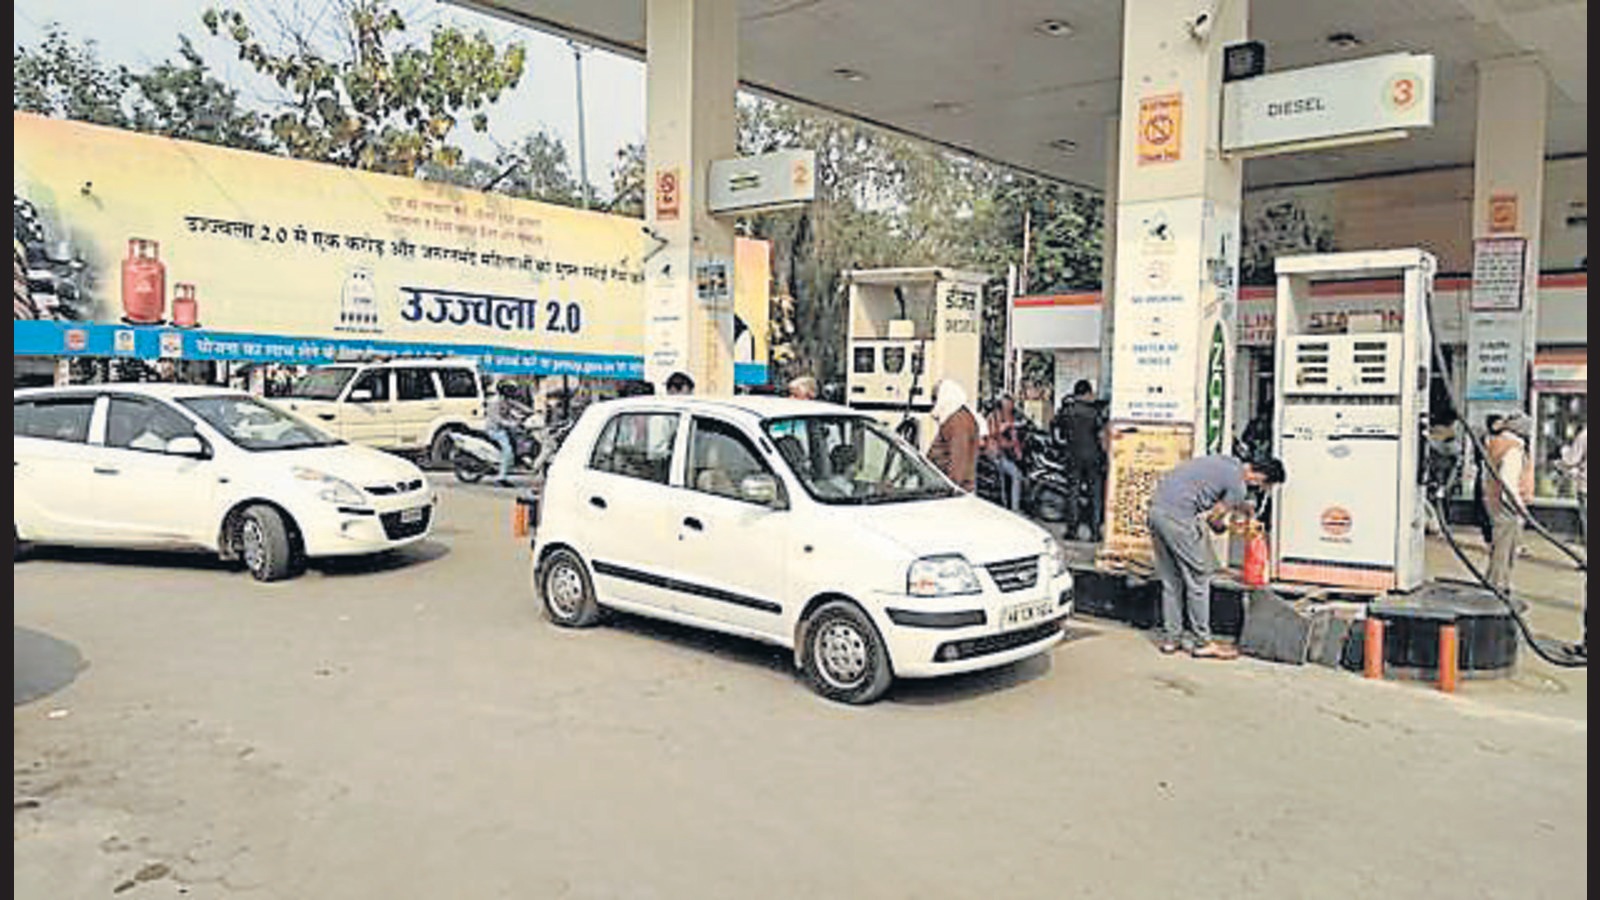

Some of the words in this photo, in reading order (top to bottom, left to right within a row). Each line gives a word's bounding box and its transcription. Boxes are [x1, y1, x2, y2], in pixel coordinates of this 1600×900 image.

[1393, 78, 1414, 106] 3
[1268, 98, 1325, 117] DIESEL
[793, 165, 808, 184] 2
[260, 224, 288, 244] 2.0
[312, 231, 340, 252] एक
[391, 237, 416, 257] और
[400, 286, 538, 331] उज्ज्वला
[545, 300, 581, 334] 2.0
